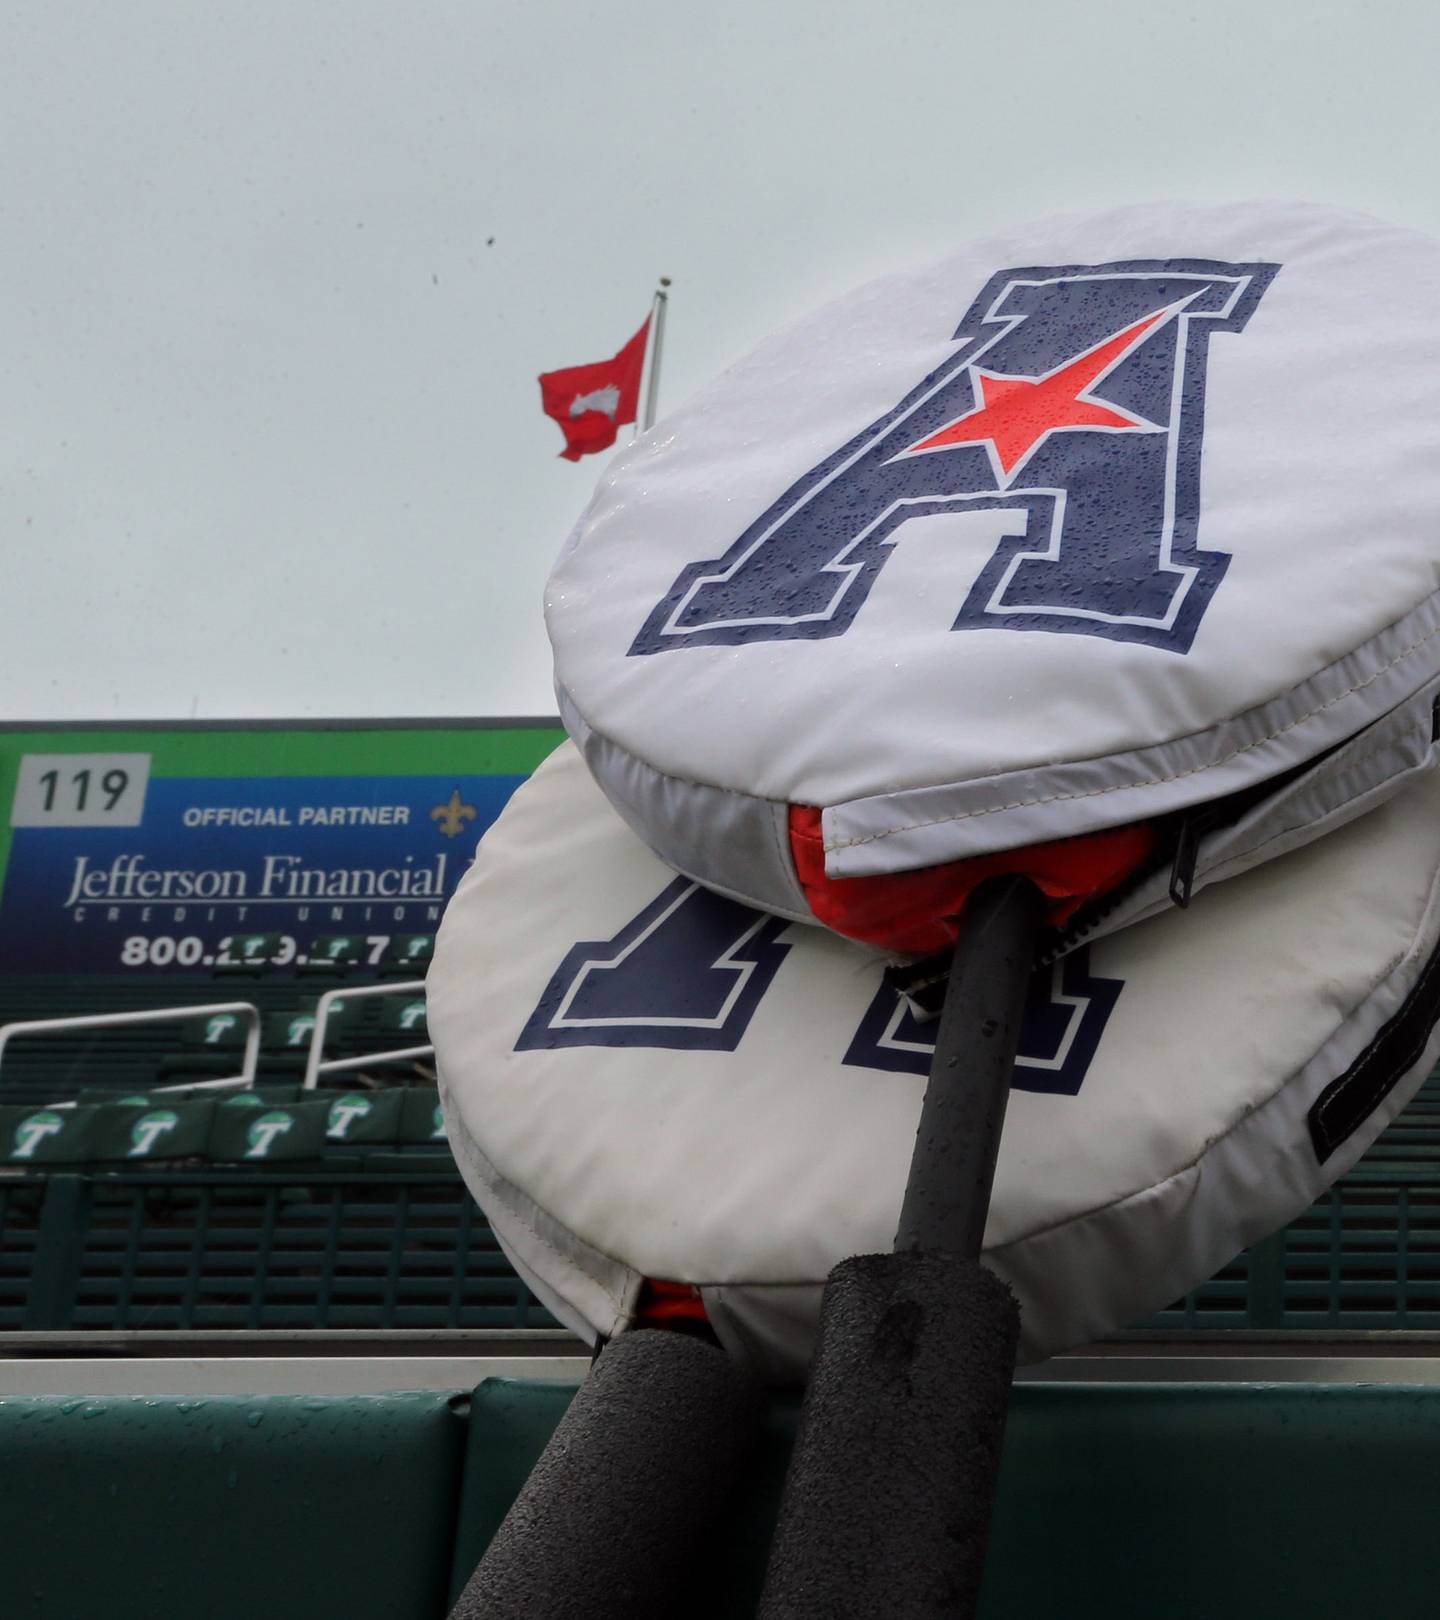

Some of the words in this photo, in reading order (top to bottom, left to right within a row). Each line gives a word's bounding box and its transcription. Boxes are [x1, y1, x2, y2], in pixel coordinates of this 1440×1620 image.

[626, 258, 1283, 656] A
[39, 769, 129, 812] 119
[182, 807, 292, 827] OFFICIAL
[298, 806, 411, 826] PARTNER
[63, 854, 246, 907] Jefferson
[258, 852, 447, 896] Financial
[73, 906, 247, 922] CREDIT
[298, 906, 439, 921] UNION
[204, 1018, 236, 1043] T
[10, 1122, 63, 1157] T
[127, 1119, 177, 1156] T
[244, 1122, 292, 1157] T
[325, 1106, 371, 1138] T
